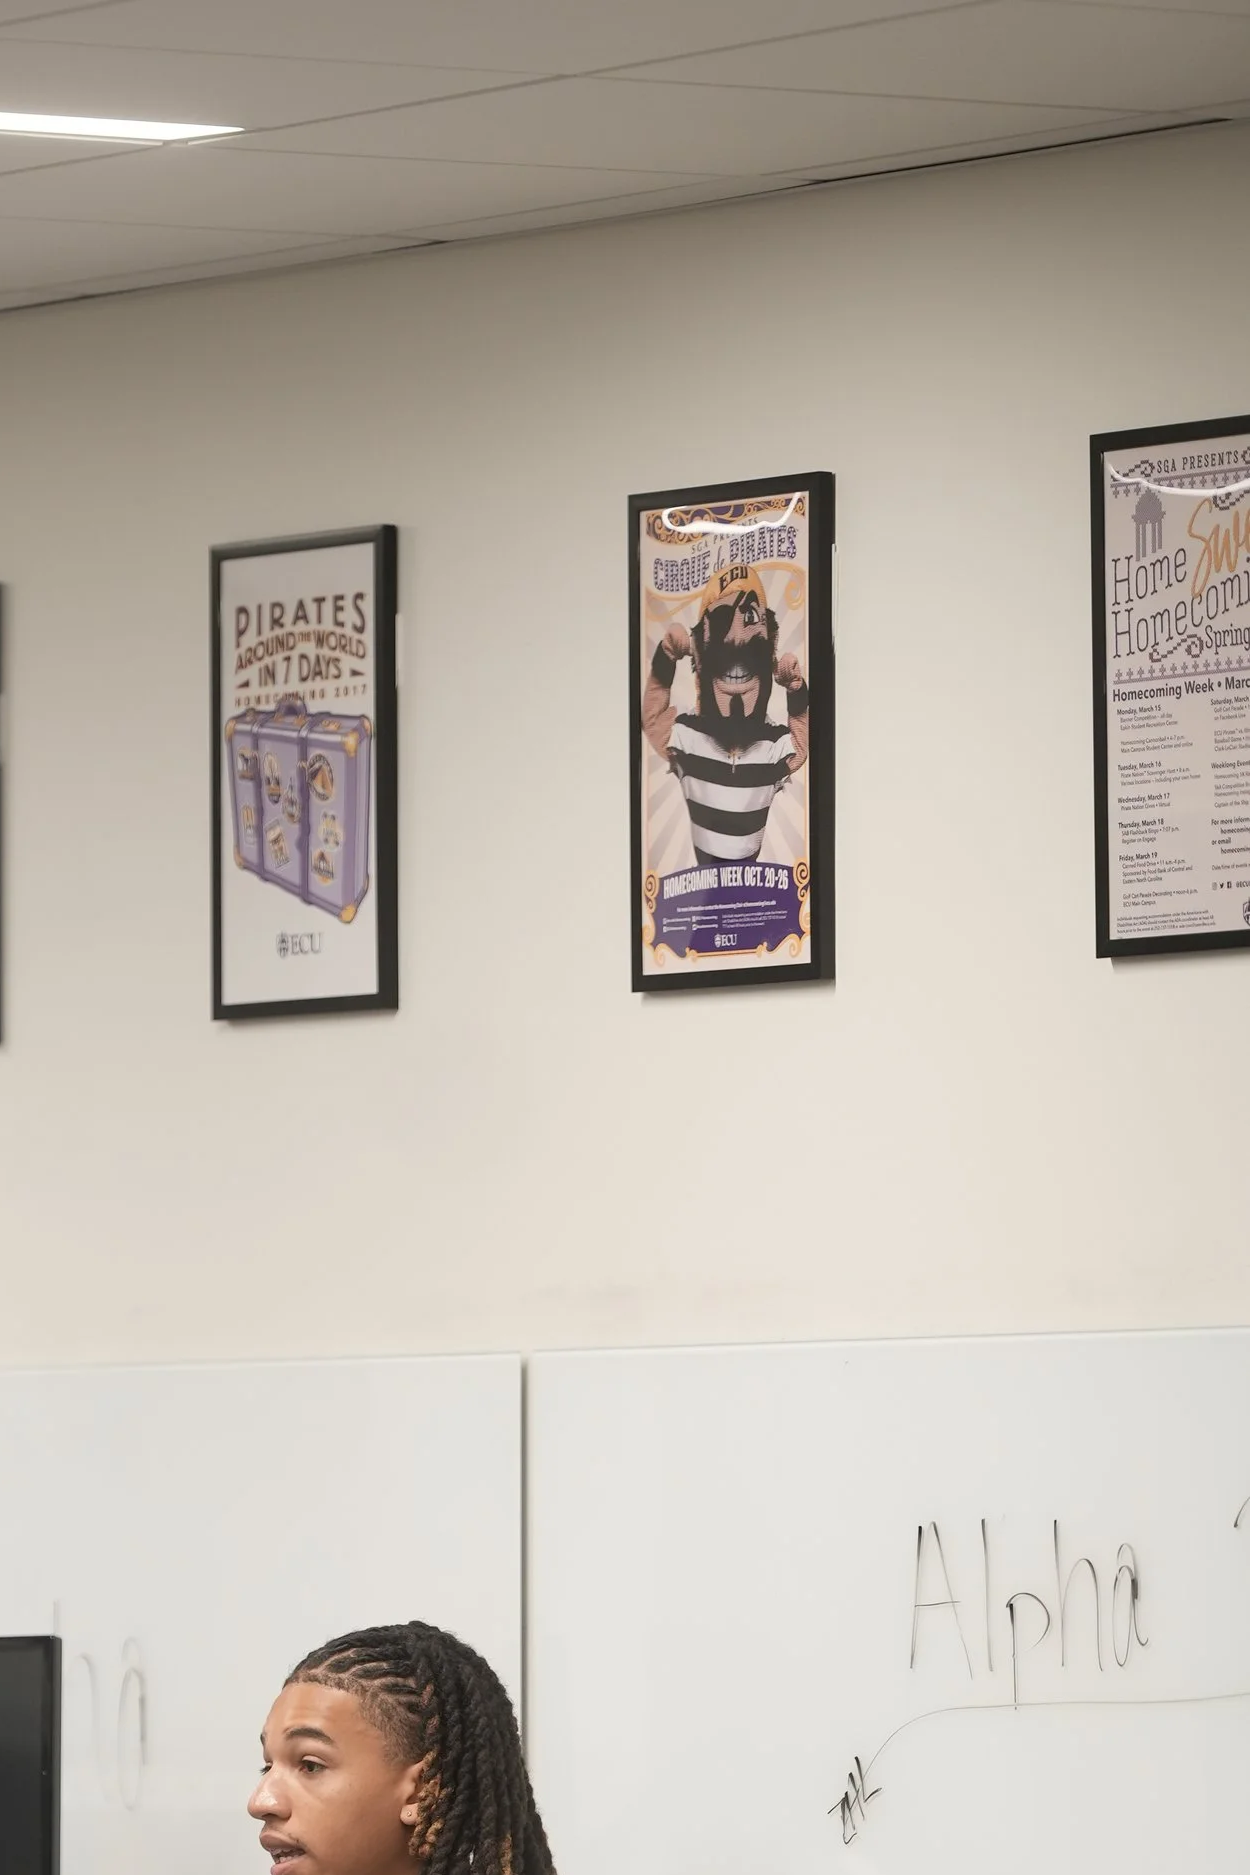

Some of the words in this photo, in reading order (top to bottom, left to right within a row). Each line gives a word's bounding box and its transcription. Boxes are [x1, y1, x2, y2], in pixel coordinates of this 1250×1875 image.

[1157, 460, 1176, 474] SGA
[1183, 450, 1239, 470] PRESENTS
[654, 551, 711, 592] CIRQUE
[712, 546, 725, 574] de
[729, 526, 797, 564] PIRATES
[719, 565, 748, 594] ECU
[1112, 548, 1187, 606] Home
[235, 592, 366, 648] PIRATES
[1205, 624, 1250, 655] Spring
[235, 632, 296, 675] AROUND
[298, 632, 312, 642] THE
[313, 630, 366, 660] WORLD
[258, 660, 276, 688] IN
[282, 655, 291, 685] 7
[298, 653, 342, 683] DAYS
[334, 684, 366, 698] 2017
[1112, 684, 1182, 702] Homecoming
[1184, 678, 1214, 694] Week
[1225, 676, 1250, 690] Marc
[1210, 696, 1233, 706] Saturday,
[1234, 694, 1248, 702] March
[1116, 706, 1137, 716] Monday,
[1138, 705, 1153, 713] March
[1118, 762, 1138, 772] Tuesday,
[1118, 794, 1146, 805] Wednesday,
[1147, 793, 1162, 801] March
[1118, 820, 1140, 830] Thursday,
[1141, 818, 1156, 826] March
[1119, 853, 1134, 862] Friday,
[664, 868, 718, 899] HOMECOMING
[720, 866, 742, 887] WEEK
[744, 866, 763, 887] OCT.
[764, 867, 789, 890] 20-26
[290, 932, 323, 956] ECU
[722, 934, 738, 947] ECU
[909, 1518, 1149, 1710] Alpha
